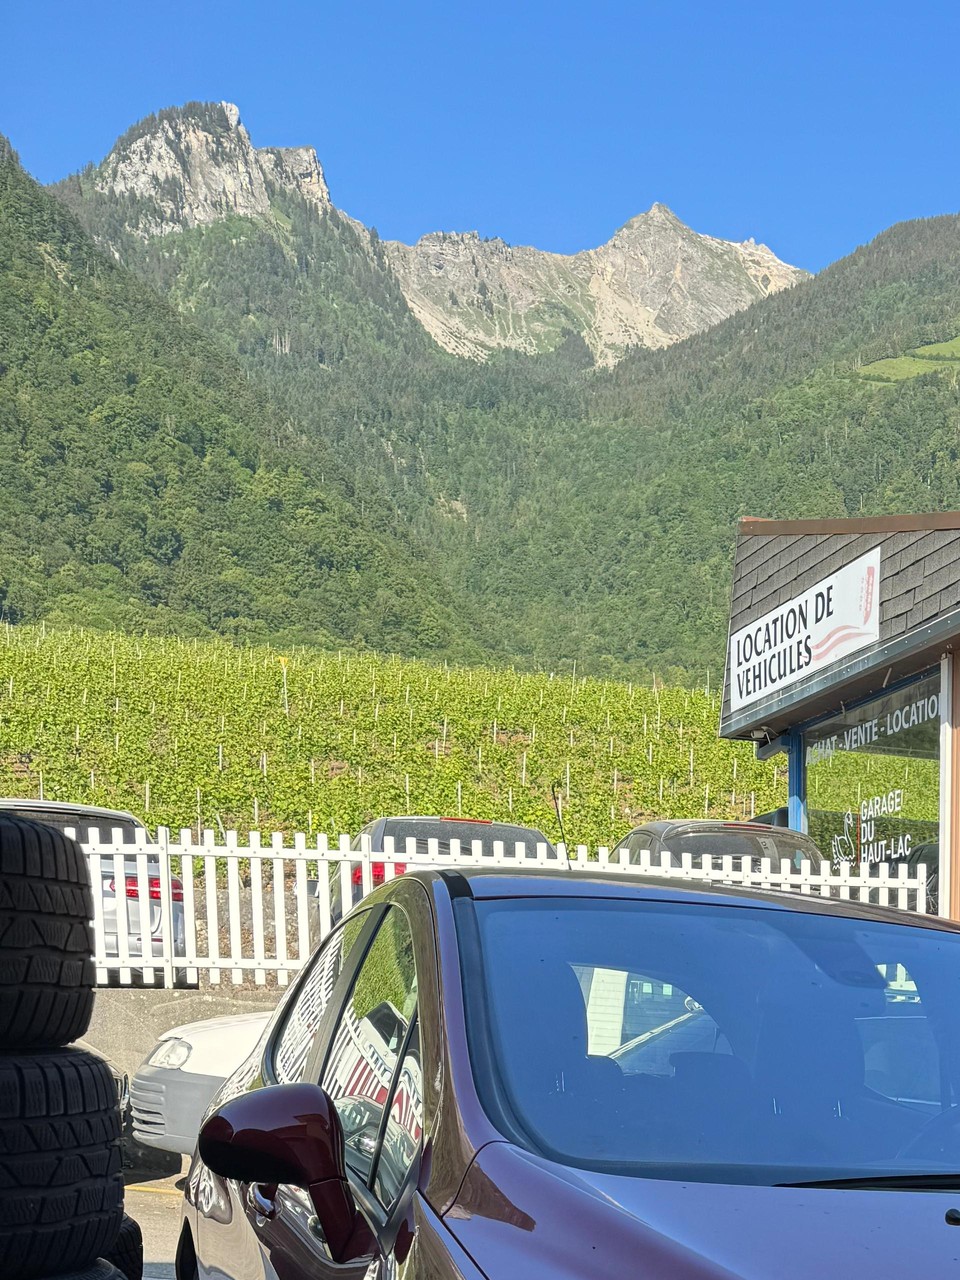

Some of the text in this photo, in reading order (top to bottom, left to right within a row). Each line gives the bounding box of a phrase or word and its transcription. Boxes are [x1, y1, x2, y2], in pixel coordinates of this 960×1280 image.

[737, 600, 808, 668] LOCATION
[814, 585, 834, 625] DE
[737, 634, 812, 699] VEHICULES
[844, 718, 878, 750] VENTE
[887, 692, 941, 736] LOCATIO
[861, 789, 902, 820] GARAGE
[861, 820, 874, 844] DU
[861, 834, 912, 864] HAUT-LAC
